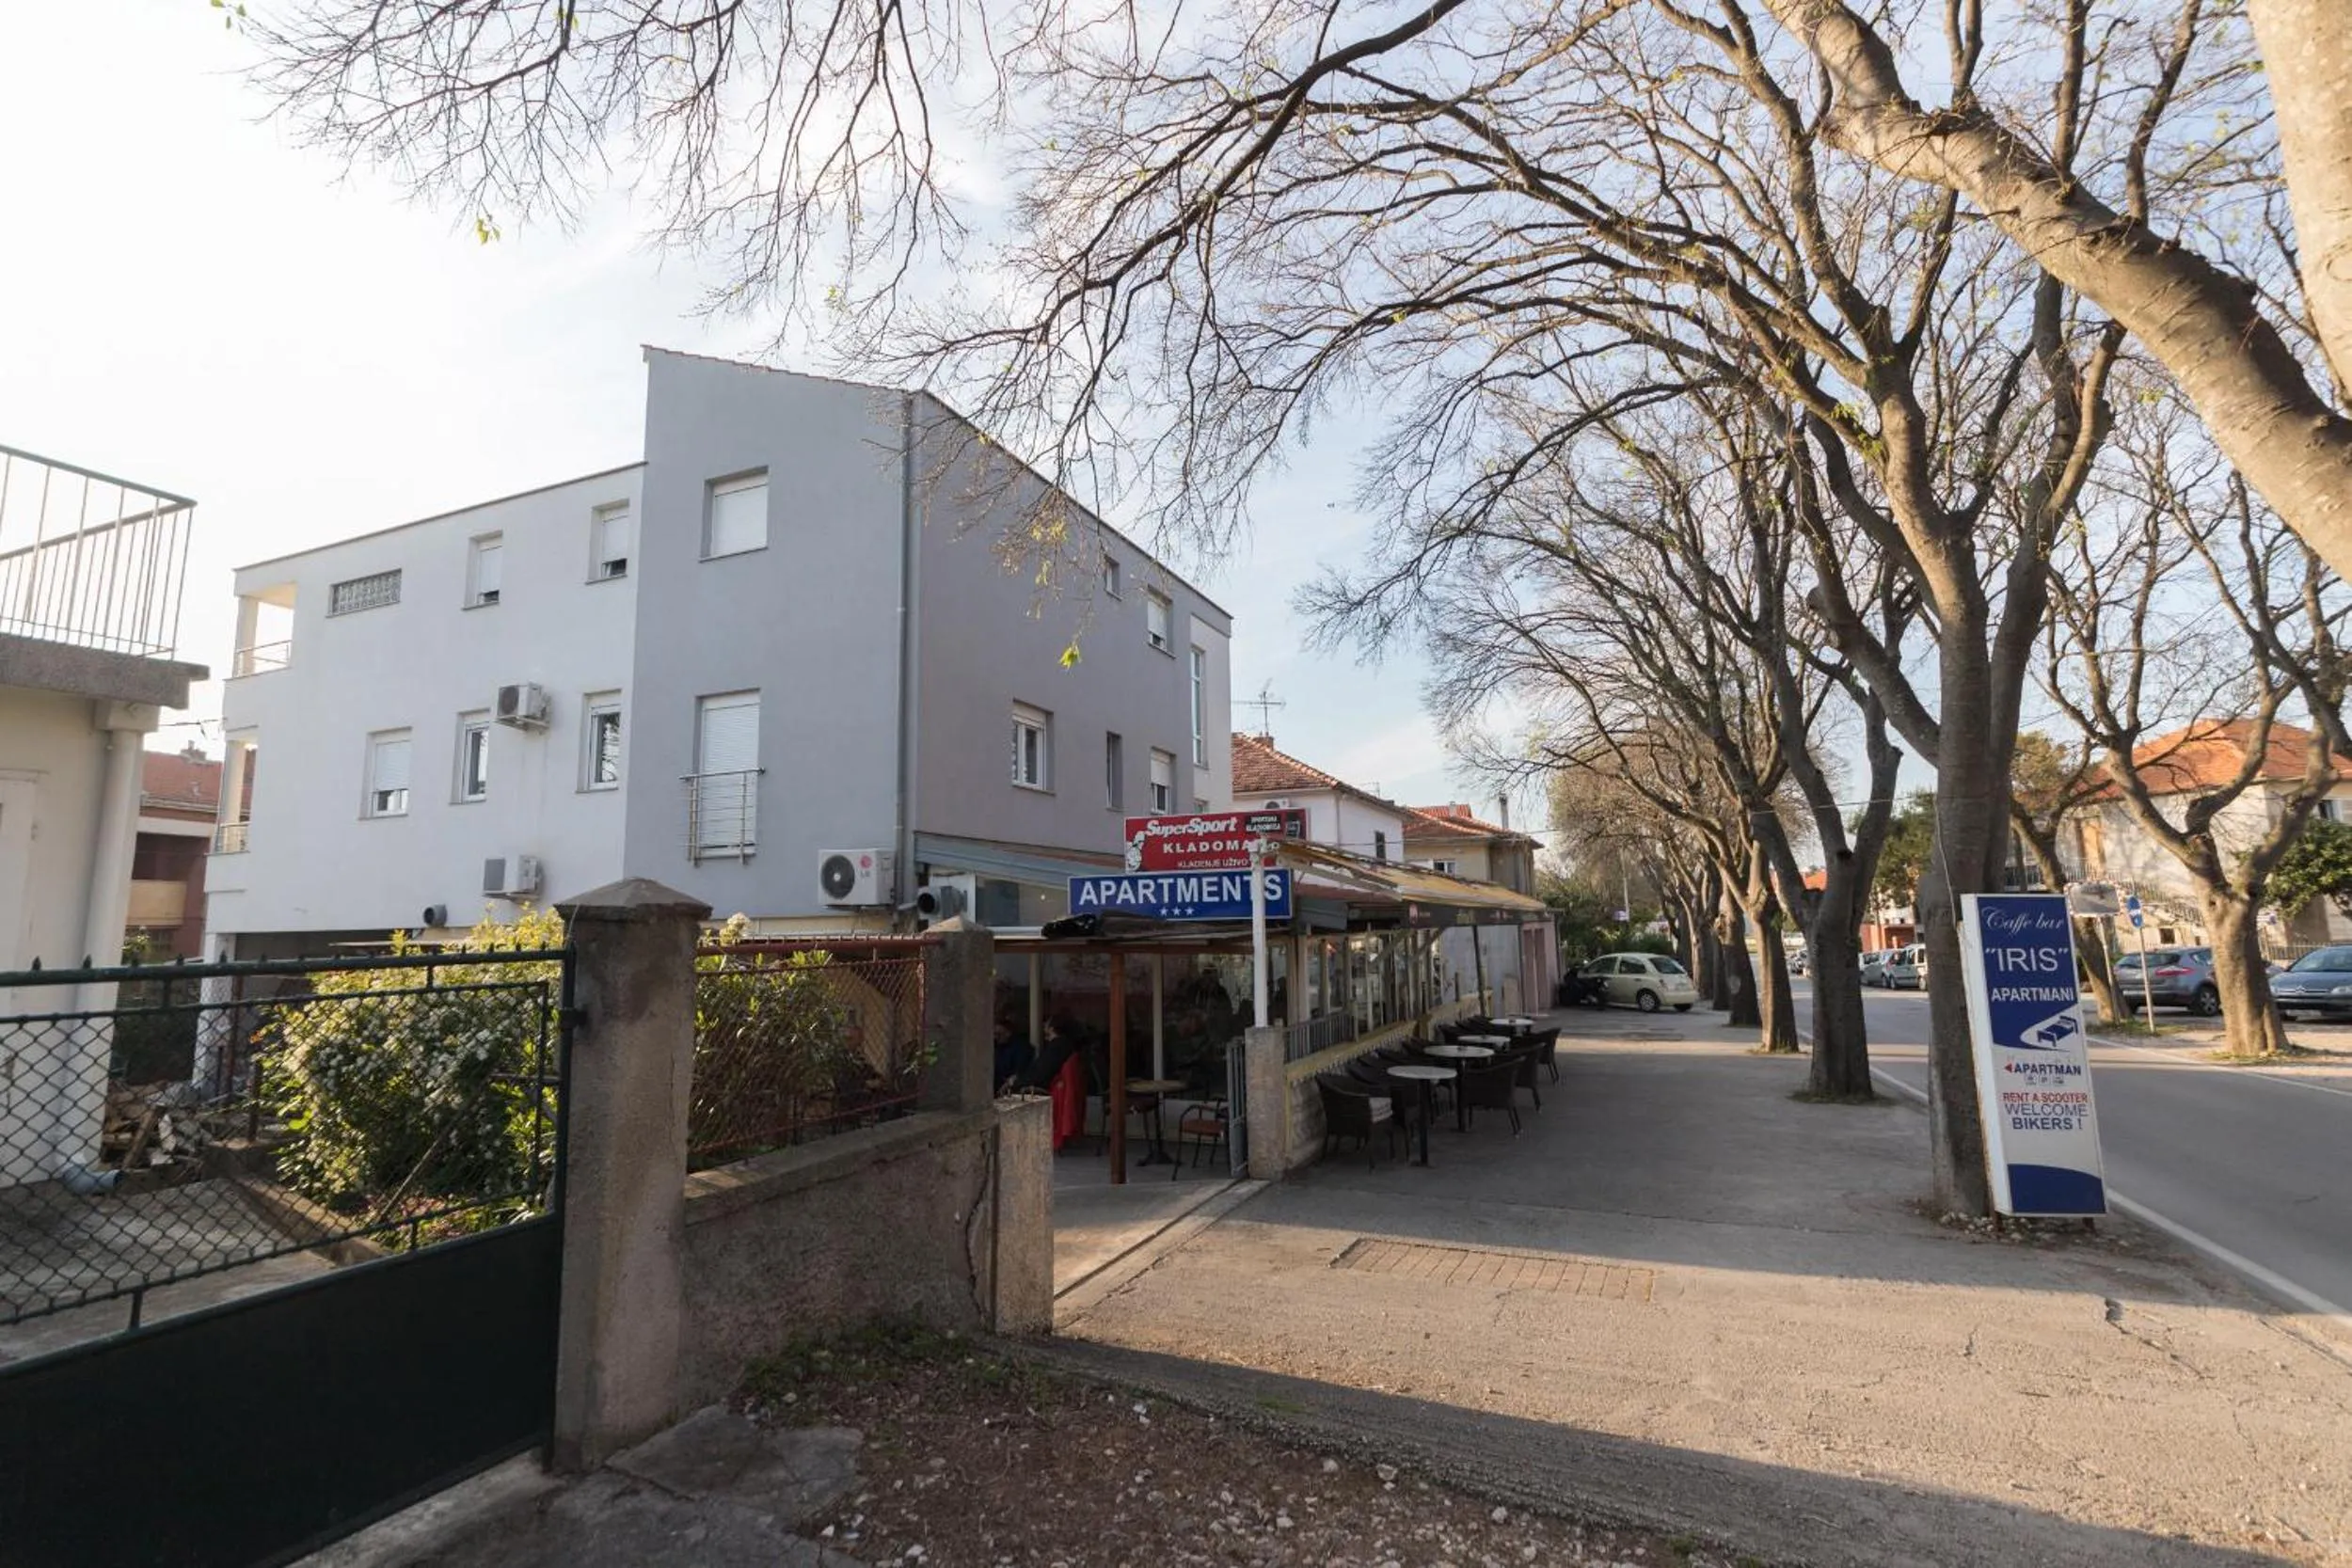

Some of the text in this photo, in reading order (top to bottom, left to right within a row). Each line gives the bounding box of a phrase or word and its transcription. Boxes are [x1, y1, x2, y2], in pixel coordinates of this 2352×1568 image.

[1145, 816, 1238, 836] SuperSport
[1163, 838, 1266, 854] KLADOMA
[2036, 911, 2064, 929] bar
[1991, 988, 2074, 1002] APARTMANI
[2014, 1063, 2081, 1076] APARTMAN
[2003, 1092, 2088, 1103] RENT A SCOOTER
[2005, 1103, 2089, 1117] WELCOME
[2011, 1117, 2073, 1130] BIKERS
